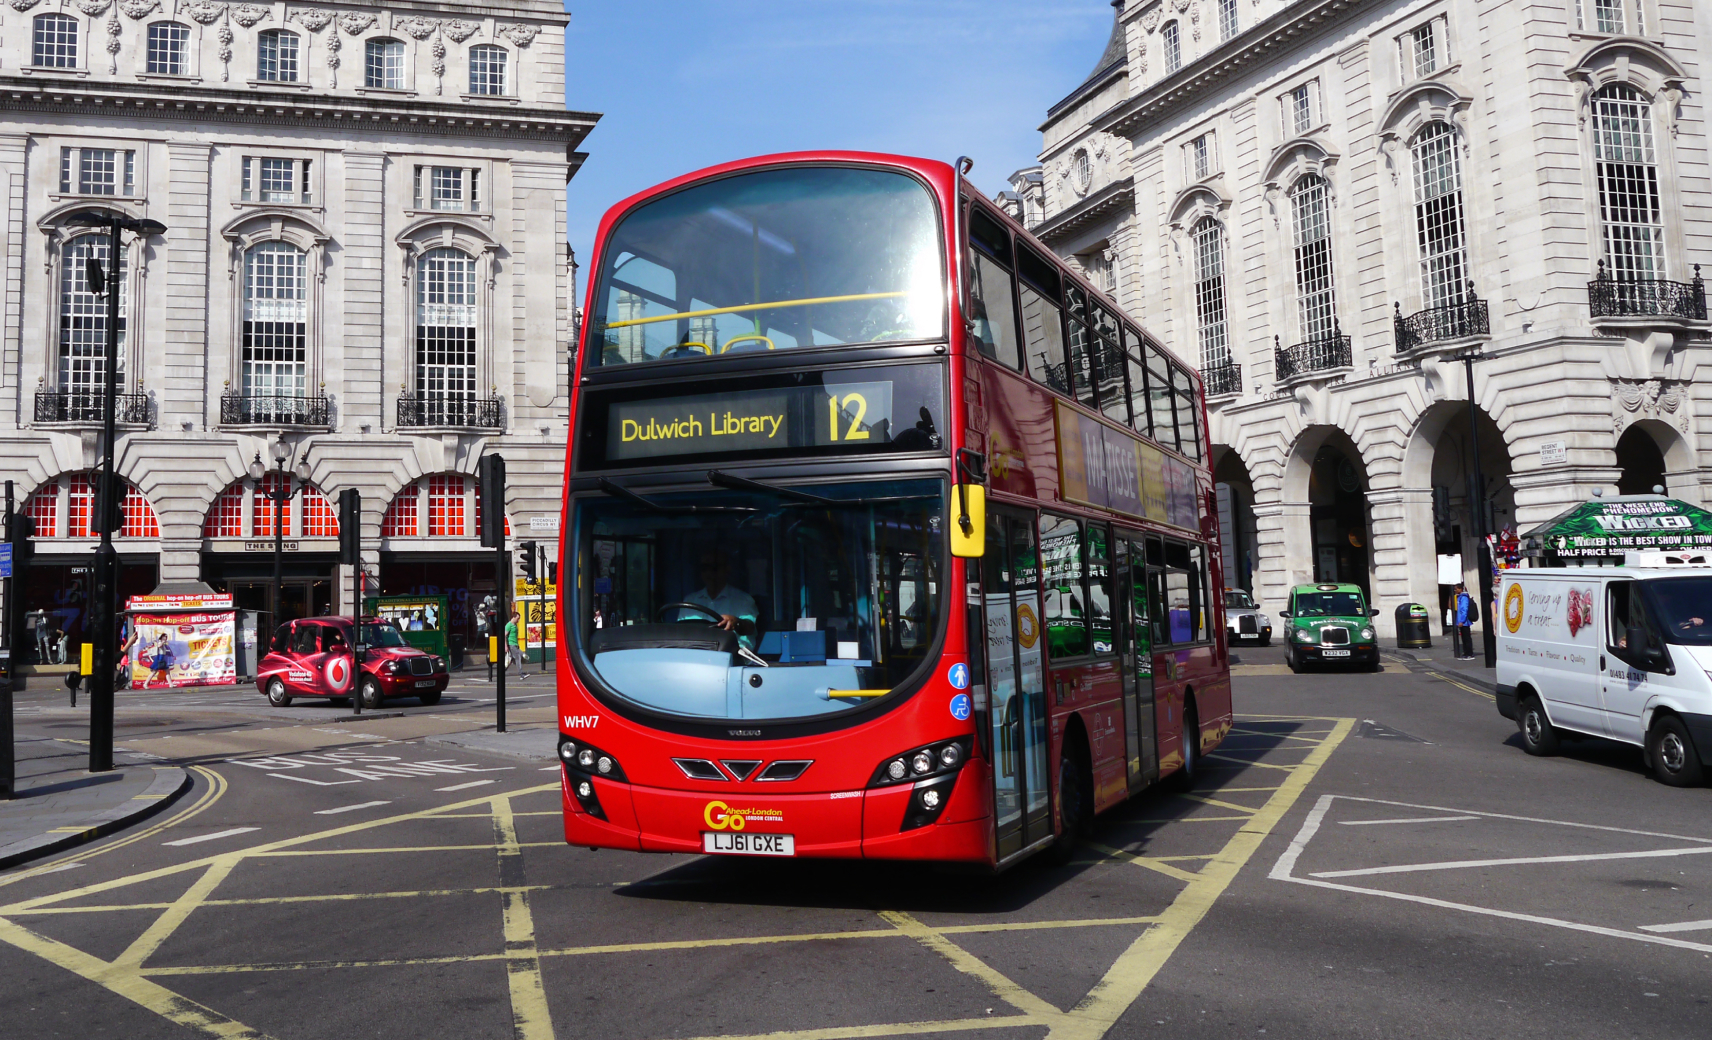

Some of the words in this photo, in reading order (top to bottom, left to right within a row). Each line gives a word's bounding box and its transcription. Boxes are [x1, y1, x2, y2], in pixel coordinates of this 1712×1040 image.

[1263, 388, 1293, 400] COUNT
[1369, 361, 1418, 378] ALLIANC
[828, 392, 870, 441] 12
[621, 414, 702, 442] Dulwich
[710, 411, 784, 438] Library
[1085, 432, 1136, 499] MATISSE
[1609, 537, 1617, 546] IS
[1619, 536, 1634, 545] THE
[1636, 536, 1656, 545] BEST
[1658, 535, 1681, 544] SHOW
[1683, 535, 1693, 544] IN
[1582, 548, 1606, 556] PRICE
[444, 588, 469, 601] TO
[1552, 593, 1562, 613] up
[208, 613, 235, 621] TOURS
[1505, 645, 1520, 654] Tradition
[1528, 648, 1538, 656] Taste
[1546, 650, 1560, 659] Flavour
[1570, 653, 1586, 665] Quality
[564, 715, 600, 729] WHV7
[229, 752, 402, 770] BUS
[266, 759, 517, 786] LANE
[830, 791, 861, 799] SCREENWASH
[704, 800, 745, 831] Go
[725, 807, 783, 816] Ahead-London
[714, 833, 748, 851] LJ61
[753, 835, 784, 852] GXE
